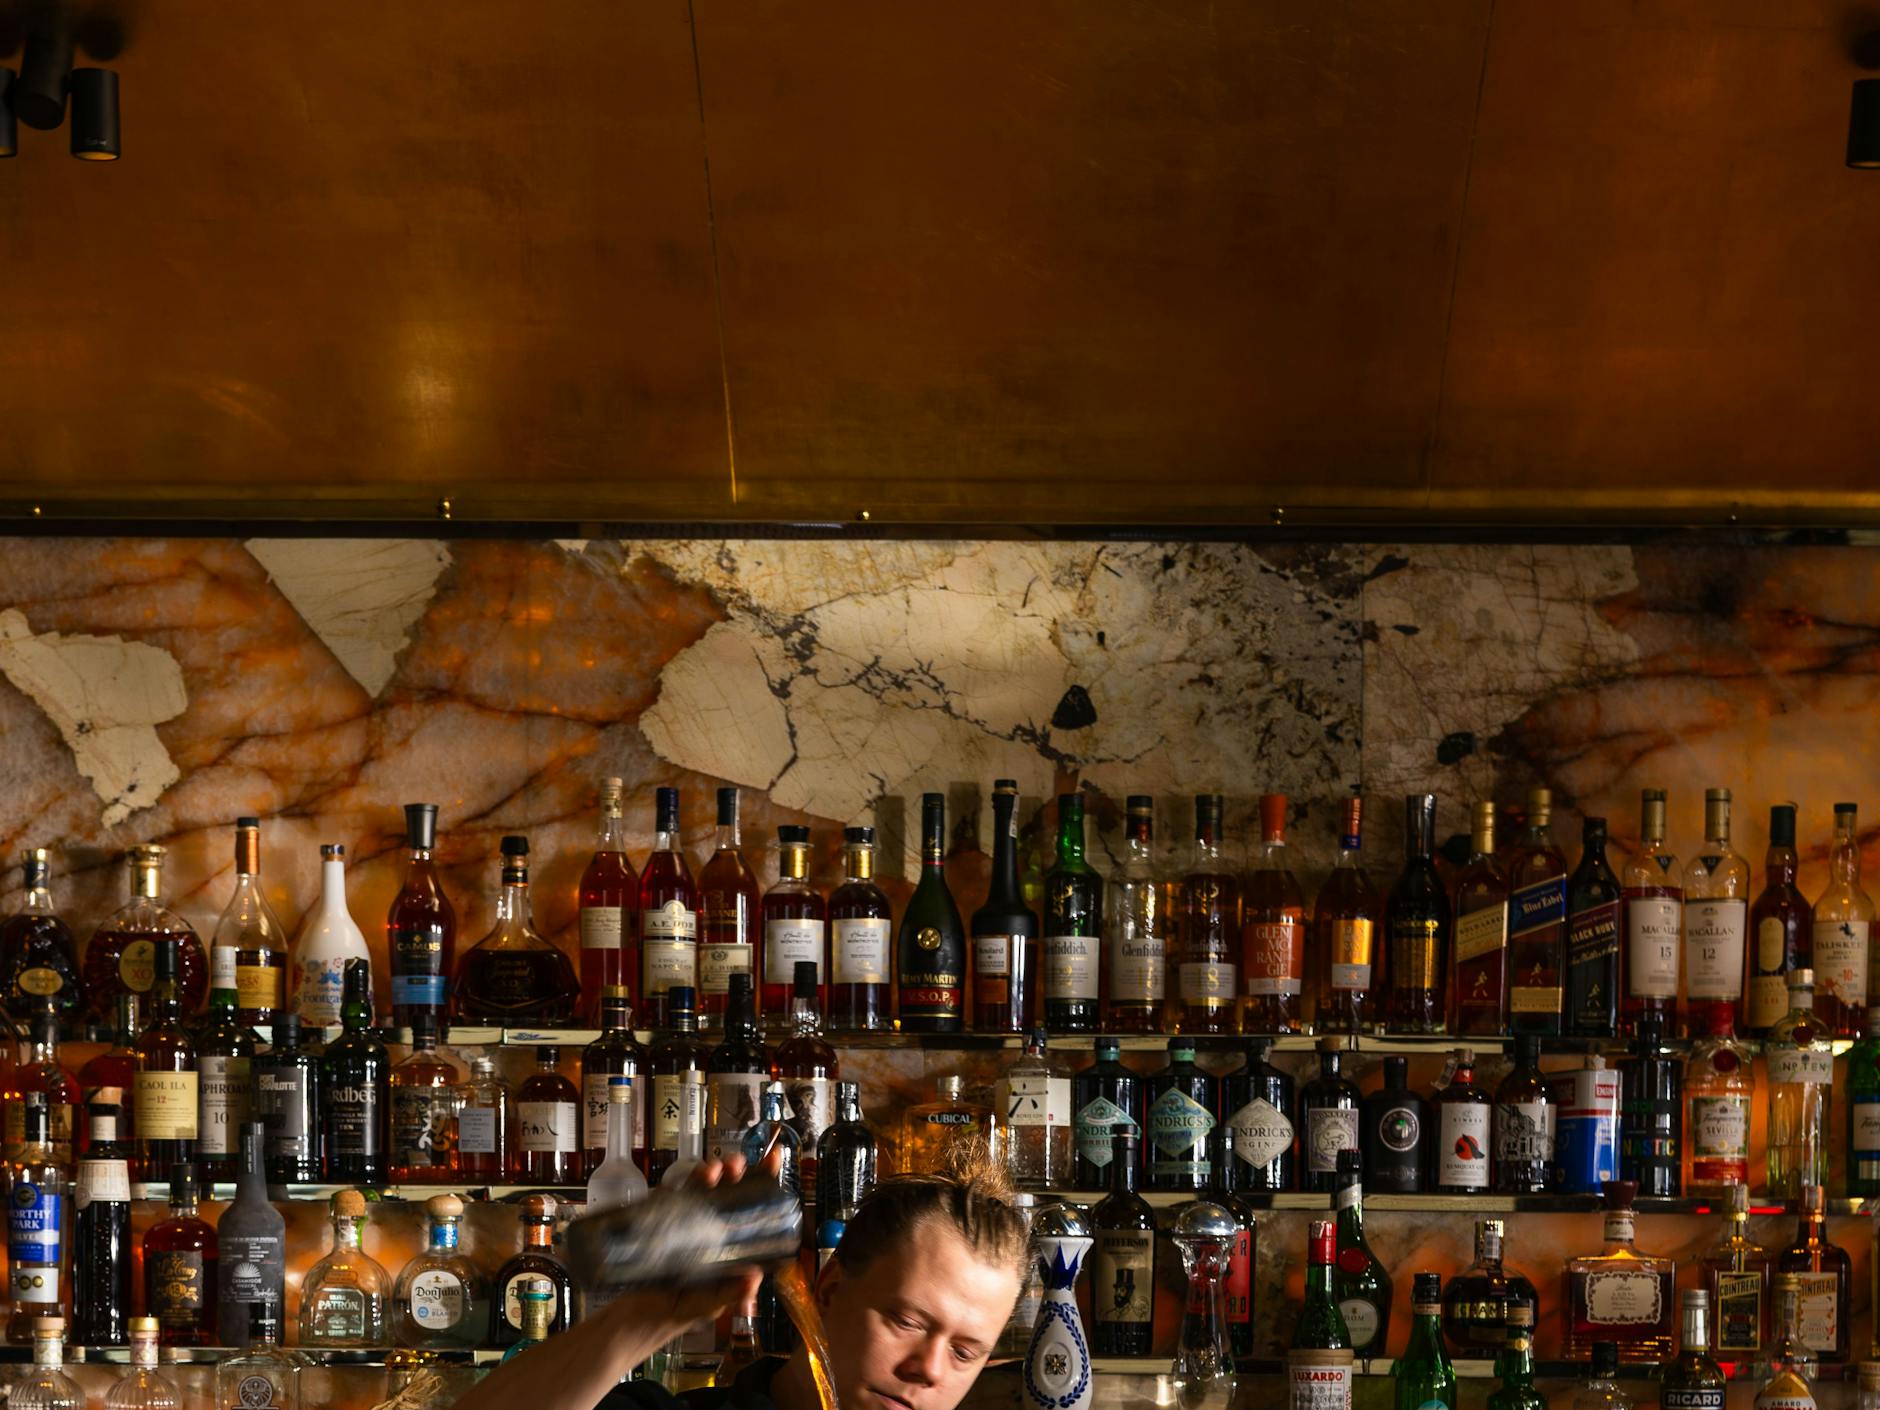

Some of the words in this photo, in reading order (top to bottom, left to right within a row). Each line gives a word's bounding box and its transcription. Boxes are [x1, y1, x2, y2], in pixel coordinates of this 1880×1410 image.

[1256, 926, 1290, 940] GLEN
[396, 941, 441, 952] CAMUS
[1703, 947, 1716, 961] 12
[139, 1079, 168, 1090] CAOL
[169, 1079, 187, 1090] ILA
[214, 1110, 230, 1124] 10
[1248, 1141, 1271, 1149] GIN
[1667, 1393, 1721, 1406] RICARD
